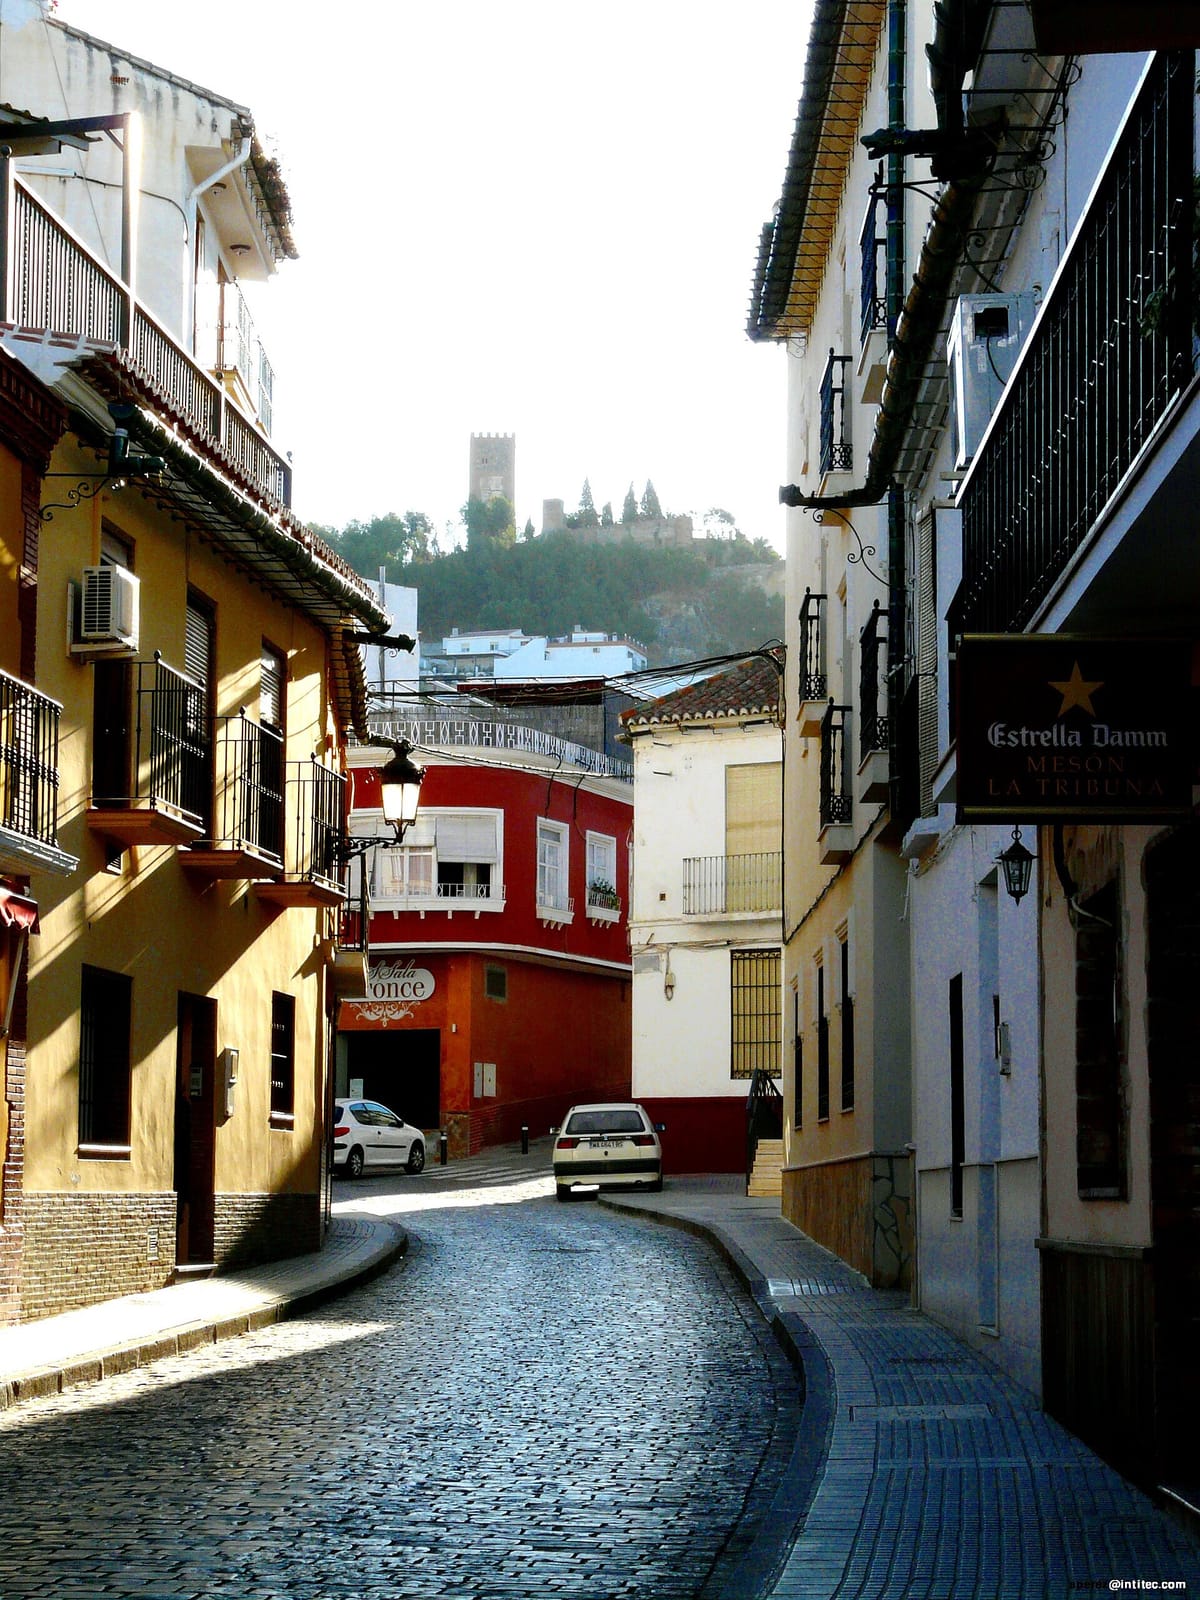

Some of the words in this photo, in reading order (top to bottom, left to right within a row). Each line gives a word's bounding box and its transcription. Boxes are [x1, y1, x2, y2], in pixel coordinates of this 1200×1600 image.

[987, 721, 1082, 748] Estrella
[1090, 722, 1169, 748] Damm
[986, 778, 1022, 797] LA
[1036, 778, 1166, 797] TRIBUNA
